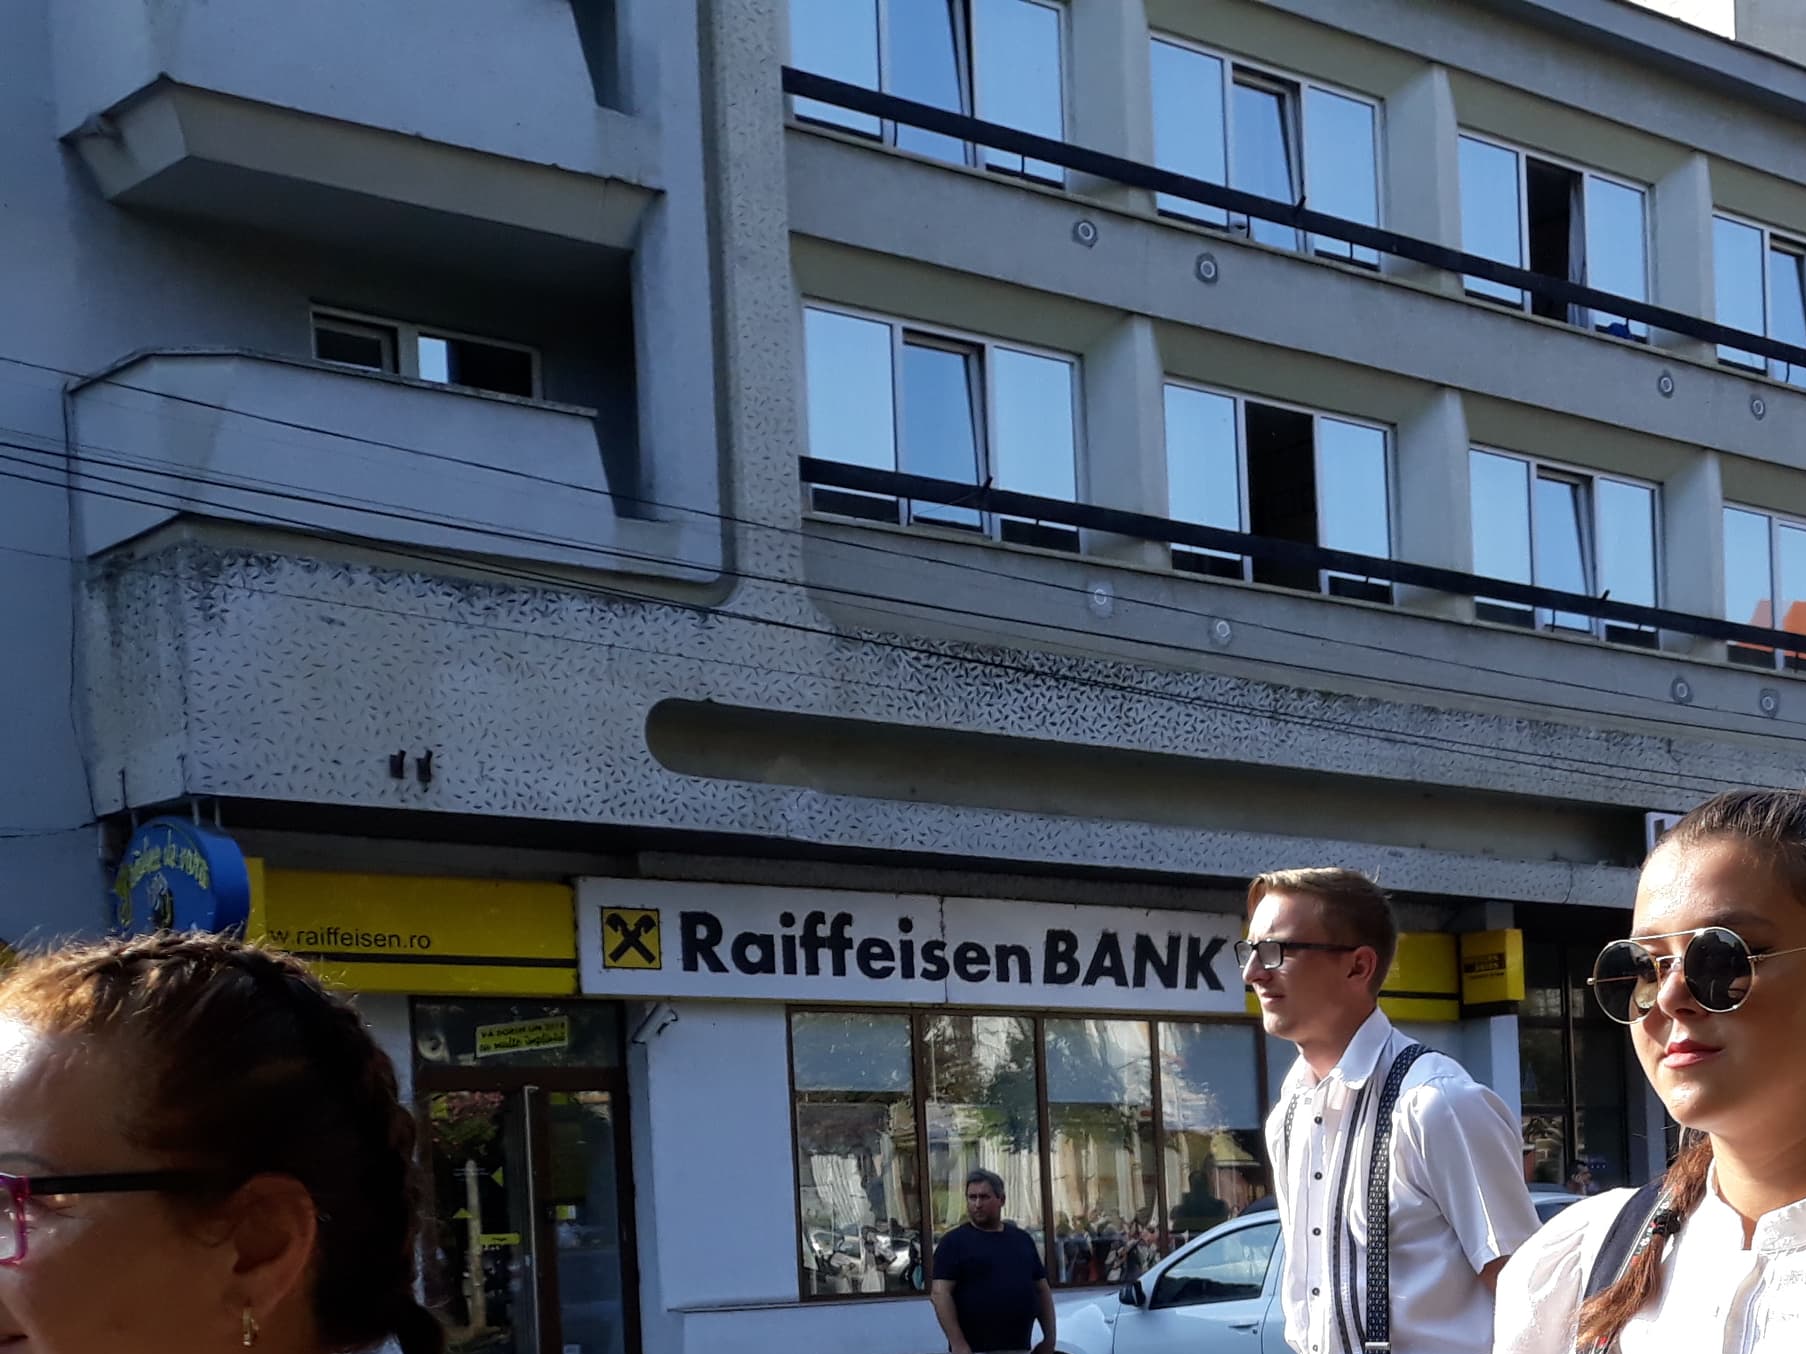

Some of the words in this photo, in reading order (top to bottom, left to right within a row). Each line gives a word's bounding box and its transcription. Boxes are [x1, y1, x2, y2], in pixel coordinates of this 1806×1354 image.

[268, 926, 432, 950] w.raiffeisen.ro
[679, 911, 1033, 984] Raiffeisen
[1042, 928, 1228, 992] BANK
